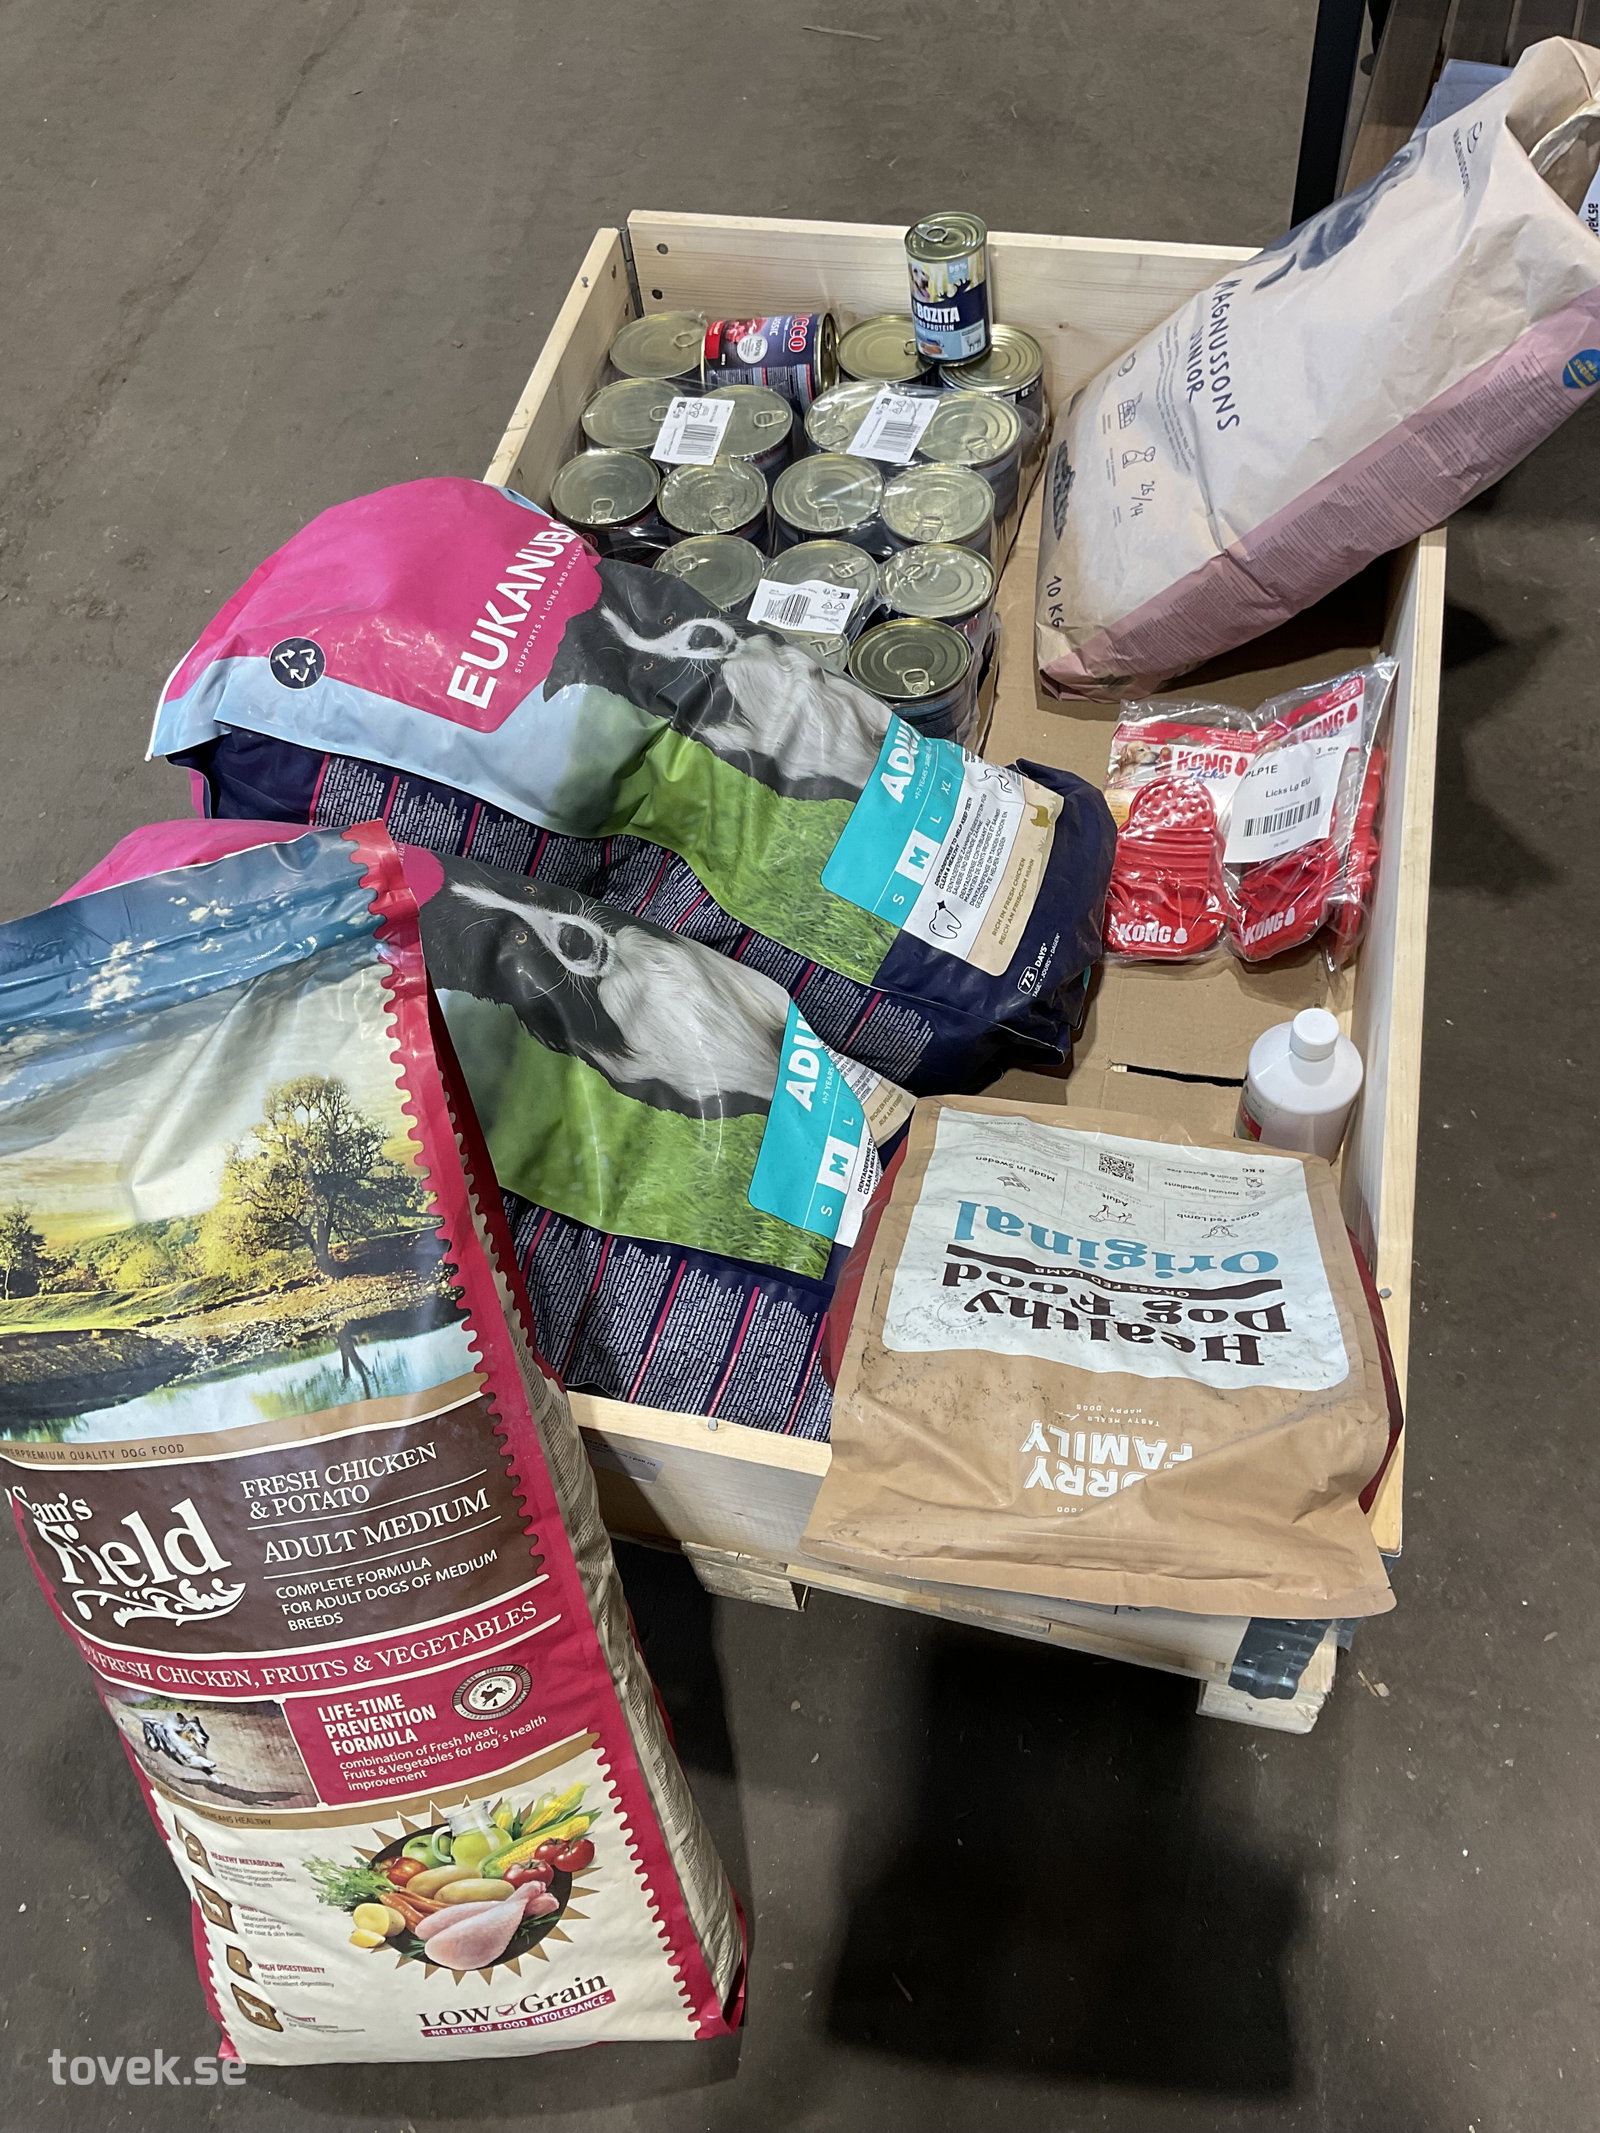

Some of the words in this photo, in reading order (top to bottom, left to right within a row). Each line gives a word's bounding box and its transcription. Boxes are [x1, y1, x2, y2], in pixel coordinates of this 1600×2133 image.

[915, 306, 960, 324] BOZITA
[927, 322, 955, 332] PROTEIN
[1187, 325, 1205, 404] JUNIOR
[1209, 279, 1243, 431] MAGNUSSONS
[1046, 576, 1062, 598] 10
[515, 623, 542, 673] SUPPORTS
[544, 589, 559, 611] LONG
[557, 571, 568, 587] AND
[1049, 603, 1065, 628] KG
[1177, 751, 1232, 774] KONG
[1265, 787, 1288, 798] Licks
[1289, 783, 1299, 792] Lg
[1301, 777, 1311, 788] EU
[892, 893, 905, 906] S
[908, 845, 931, 870] M
[929, 815, 942, 824] L
[940, 779, 952, 796] XL
[991, 919, 1003, 936] RICH
[1002, 886, 1016, 910] FRESH
[1011, 858, 1028, 886] CHICKEN
[997, 924, 1011, 945] REICH
[1010, 878, 1029, 912] FRISCHEM
[1118, 924, 1172, 944] KONG
[1245, 912, 1284, 946] KONG
[1021, 970, 1035, 989] 73
[825, 1066, 834, 1088] YEARS
[820, 1205, 833, 1217] S
[829, 1153, 849, 1177] M
[843, 1117, 854, 1126] L
[857, 1144, 872, 1193] DENTADEFENSE
[975, 1156, 1014, 1169] Sweden
[1029, 1169, 1055, 1182] Made
[863, 1174, 872, 1195] CLEAN
[1101, 1192, 1129, 1207] Adult
[1176, 1213, 1207, 1222] Lamb
[953, 1199, 1279, 1279] Original
[1034, 1266, 1084, 1279] LAMB
[1091, 1275, 1122, 1291] FED
[942, 1262, 1116, 1318] Food
[1129, 1285, 1190, 1298] GRASS
[963, 1289, 1265, 1366] Healthy
[1143, 1299, 1292, 1333] Dog
[1087, 1415, 1121, 1424] MEALS
[1127, 1417, 1160, 1427] TASTY
[70, 1447, 116, 1461] QUALITY
[122, 1447, 147, 1459] DOG
[152, 1443, 185, 1455] FOOD
[240, 1469, 319, 1499] FRESH
[325, 1442, 438, 1486] CHICKEN
[249, 1501, 269, 1520] &
[272, 1484, 370, 1516] POTATO
[264, 1529, 358, 1565] ADULT
[361, 1488, 491, 1547] MEDIUM
[33, 1498, 232, 1588] Field
[276, 1576, 355, 1600] COMPLETE
[357, 1556, 432, 1585] FORMULA
[282, 1600, 313, 1616] FOR
[315, 1591, 361, 1612] ADULT
[366, 1581, 410, 1600] DOGS
[412, 1575, 432, 1590] OF
[436, 1549, 498, 1583] MEDIUM
[287, 1612, 344, 1632] BREEDS
[98, 1652, 153, 1681] FRESH
[156, 1665, 260, 1688] CHICKEN,
[265, 1659, 346, 1686] FRUITS
[354, 1655, 375, 1673] &
[374, 1600, 538, 1668] VEGETABLES
[317, 1693, 405, 1722] LIFE-TIME
[324, 1704, 437, 1739] PREVENTION
[331, 1728, 418, 1756] FORMULA
[339, 1748, 413, 1770] combination
[415, 1744, 427, 1756] of
[429, 1737, 462, 1753] Fresh
[464, 1725, 499, 1743] Meat,
[343, 1766, 376, 1780] Fruits
[378, 1765, 388, 1776] &
[388, 1751, 454, 1776] Vegetables
[455, 1746, 472, 1758] for
[510, 1715, 547, 1737] health
[347, 1769, 427, 1791] improvement
[258, 1963, 275, 1971] HIGH
[519, 1975, 609, 2014] Grain
[451, 2027, 476, 2036] RISK
[498, 2020, 528, 2031] FOOD
